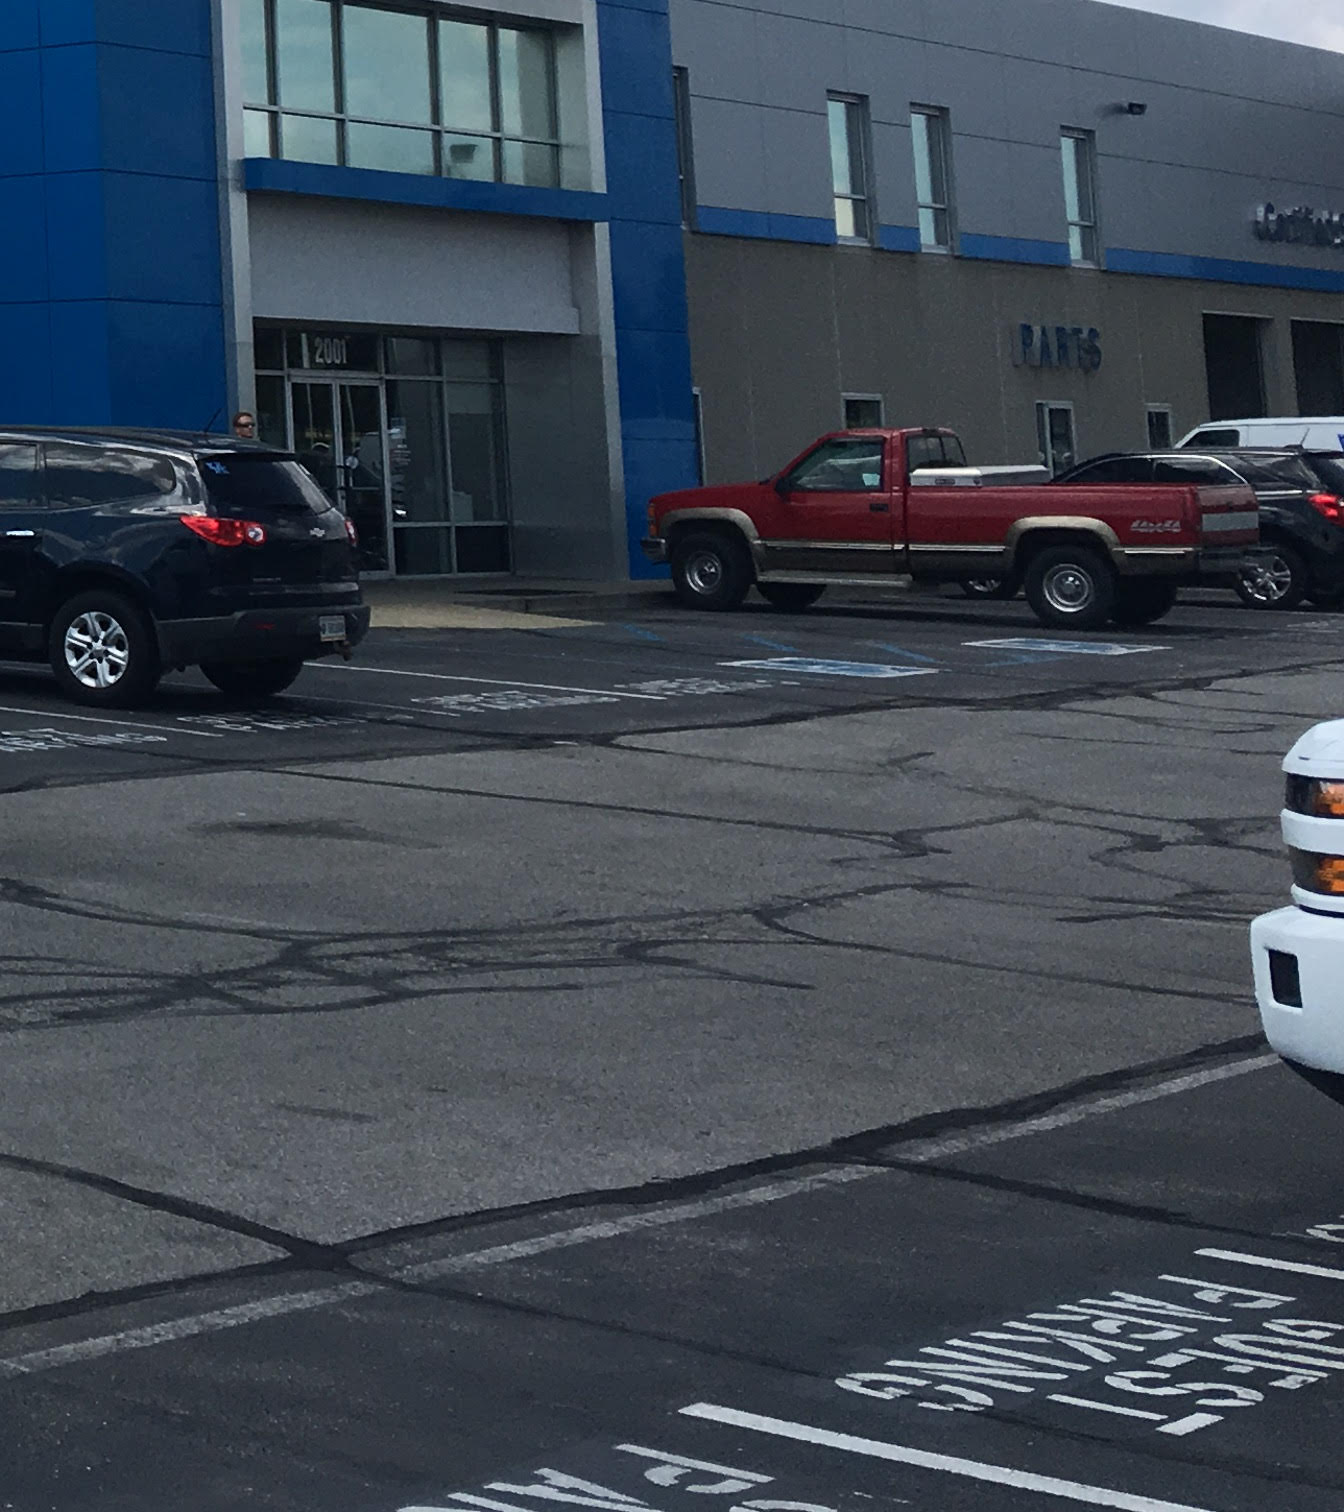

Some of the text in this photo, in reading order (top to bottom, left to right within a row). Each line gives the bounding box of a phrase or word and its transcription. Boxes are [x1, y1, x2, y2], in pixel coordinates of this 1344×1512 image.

[314, 338, 348, 364] 2001
[1014, 323, 1102, 371] PARTS
[834, 1273, 1297, 1411] PARKING
